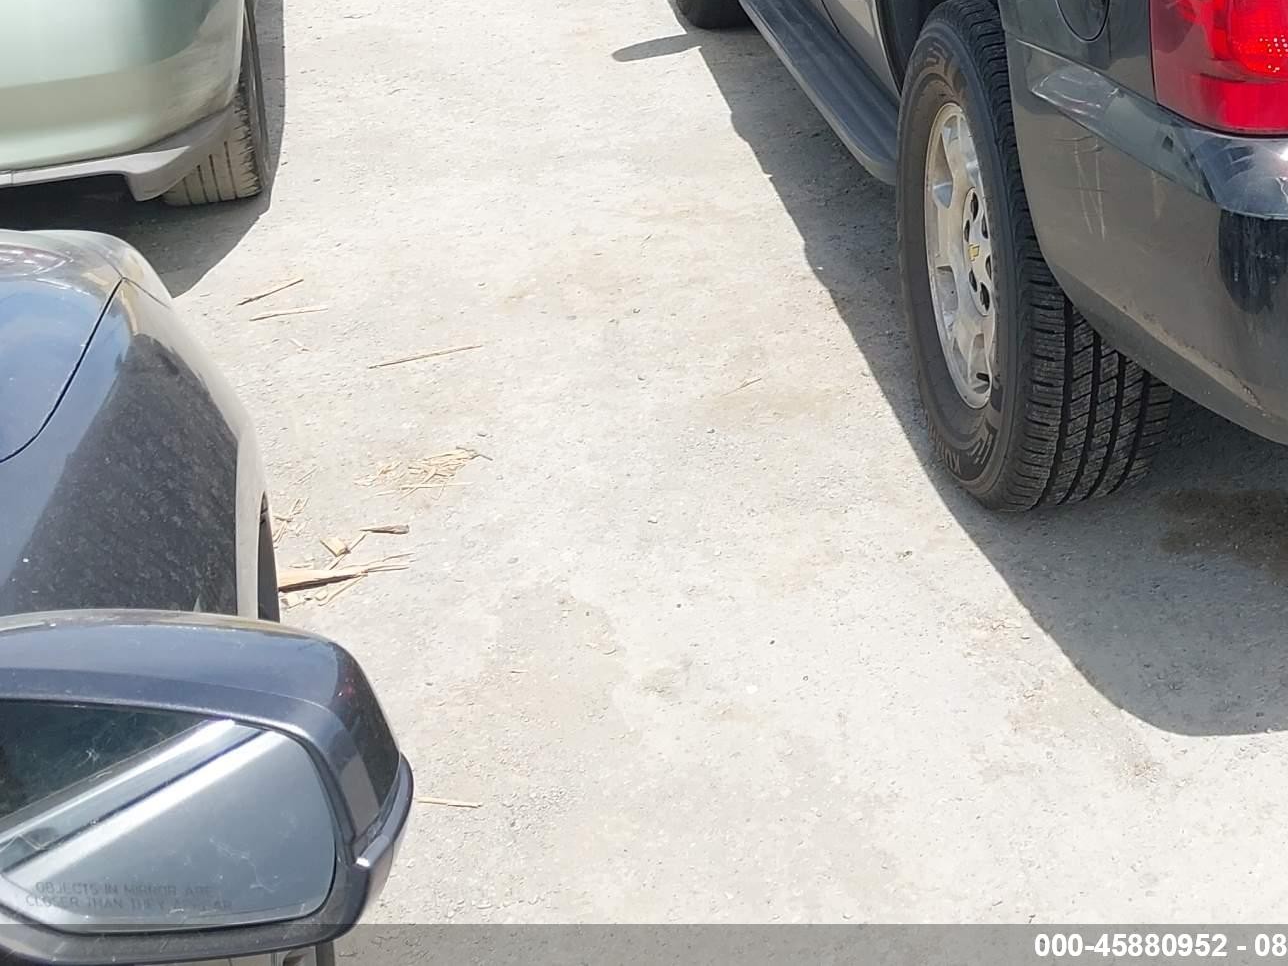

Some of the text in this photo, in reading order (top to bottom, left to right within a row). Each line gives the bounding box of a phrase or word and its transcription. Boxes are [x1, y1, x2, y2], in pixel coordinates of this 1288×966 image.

[35, 881, 98, 896] OBJECTS
[104, 882, 118, 896] IN
[124, 883, 177, 898] MIRROR
[26, 895, 81, 909] CLOSER
[86, 897, 124, 911] THAN
[173, 898, 233, 912] AEAR
